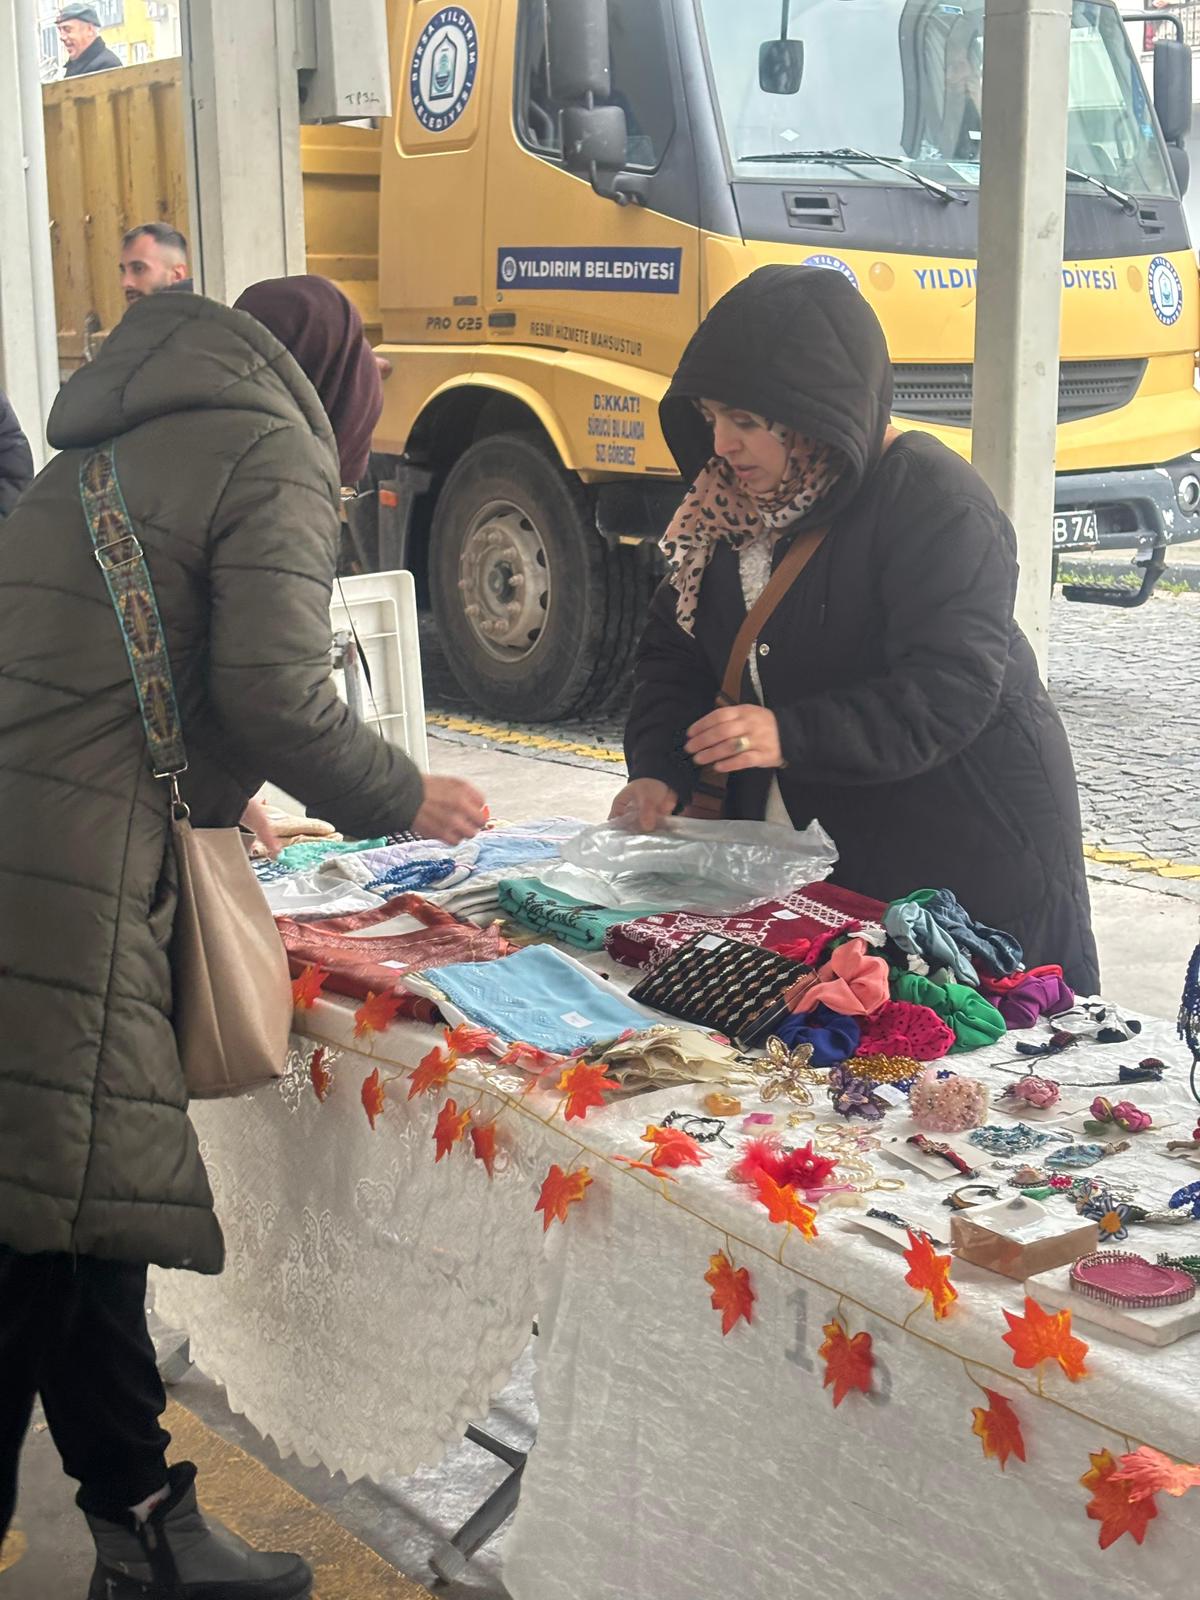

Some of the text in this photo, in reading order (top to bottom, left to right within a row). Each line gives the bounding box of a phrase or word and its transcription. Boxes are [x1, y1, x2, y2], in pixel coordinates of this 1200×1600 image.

[440, 11, 476, 64] YILDIRIM
[519, 260, 581, 278] YILDIRIM
[913, 263, 1117, 290] YILDI DİYESİ
[426, 316, 451, 330] PRO
[1071, 516, 1094, 541] 74
